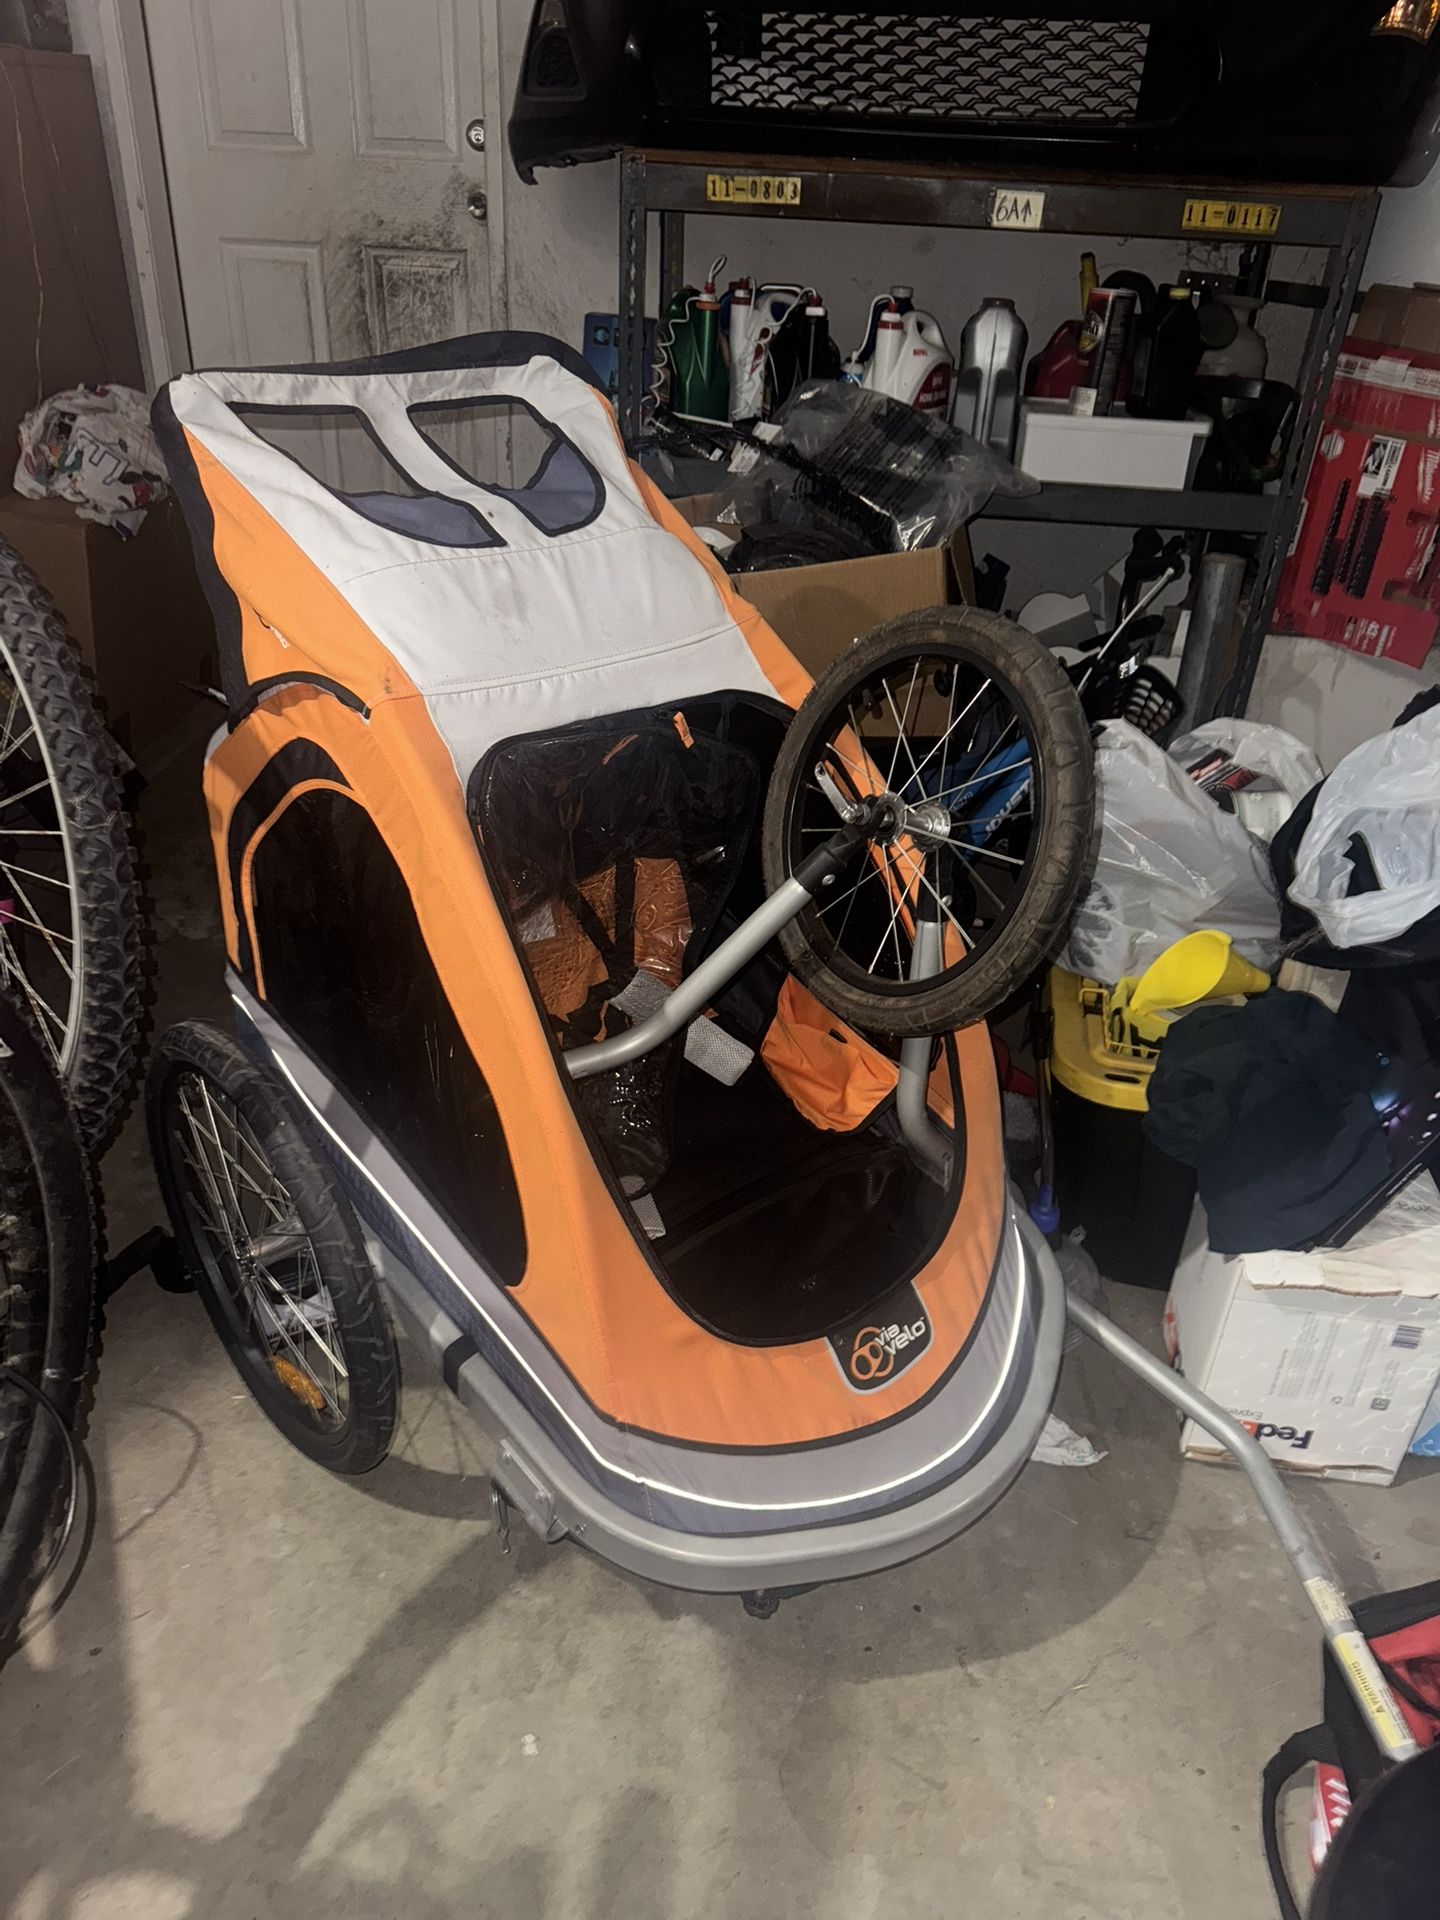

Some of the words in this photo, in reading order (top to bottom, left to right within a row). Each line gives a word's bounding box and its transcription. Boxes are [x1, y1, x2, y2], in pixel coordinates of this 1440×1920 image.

[709, 178, 799, 201] 11-0803
[1185, 203, 1279, 228] 11-0117
[874, 1323, 900, 1346] via
[1351, 1660, 1381, 1706] WARNING
